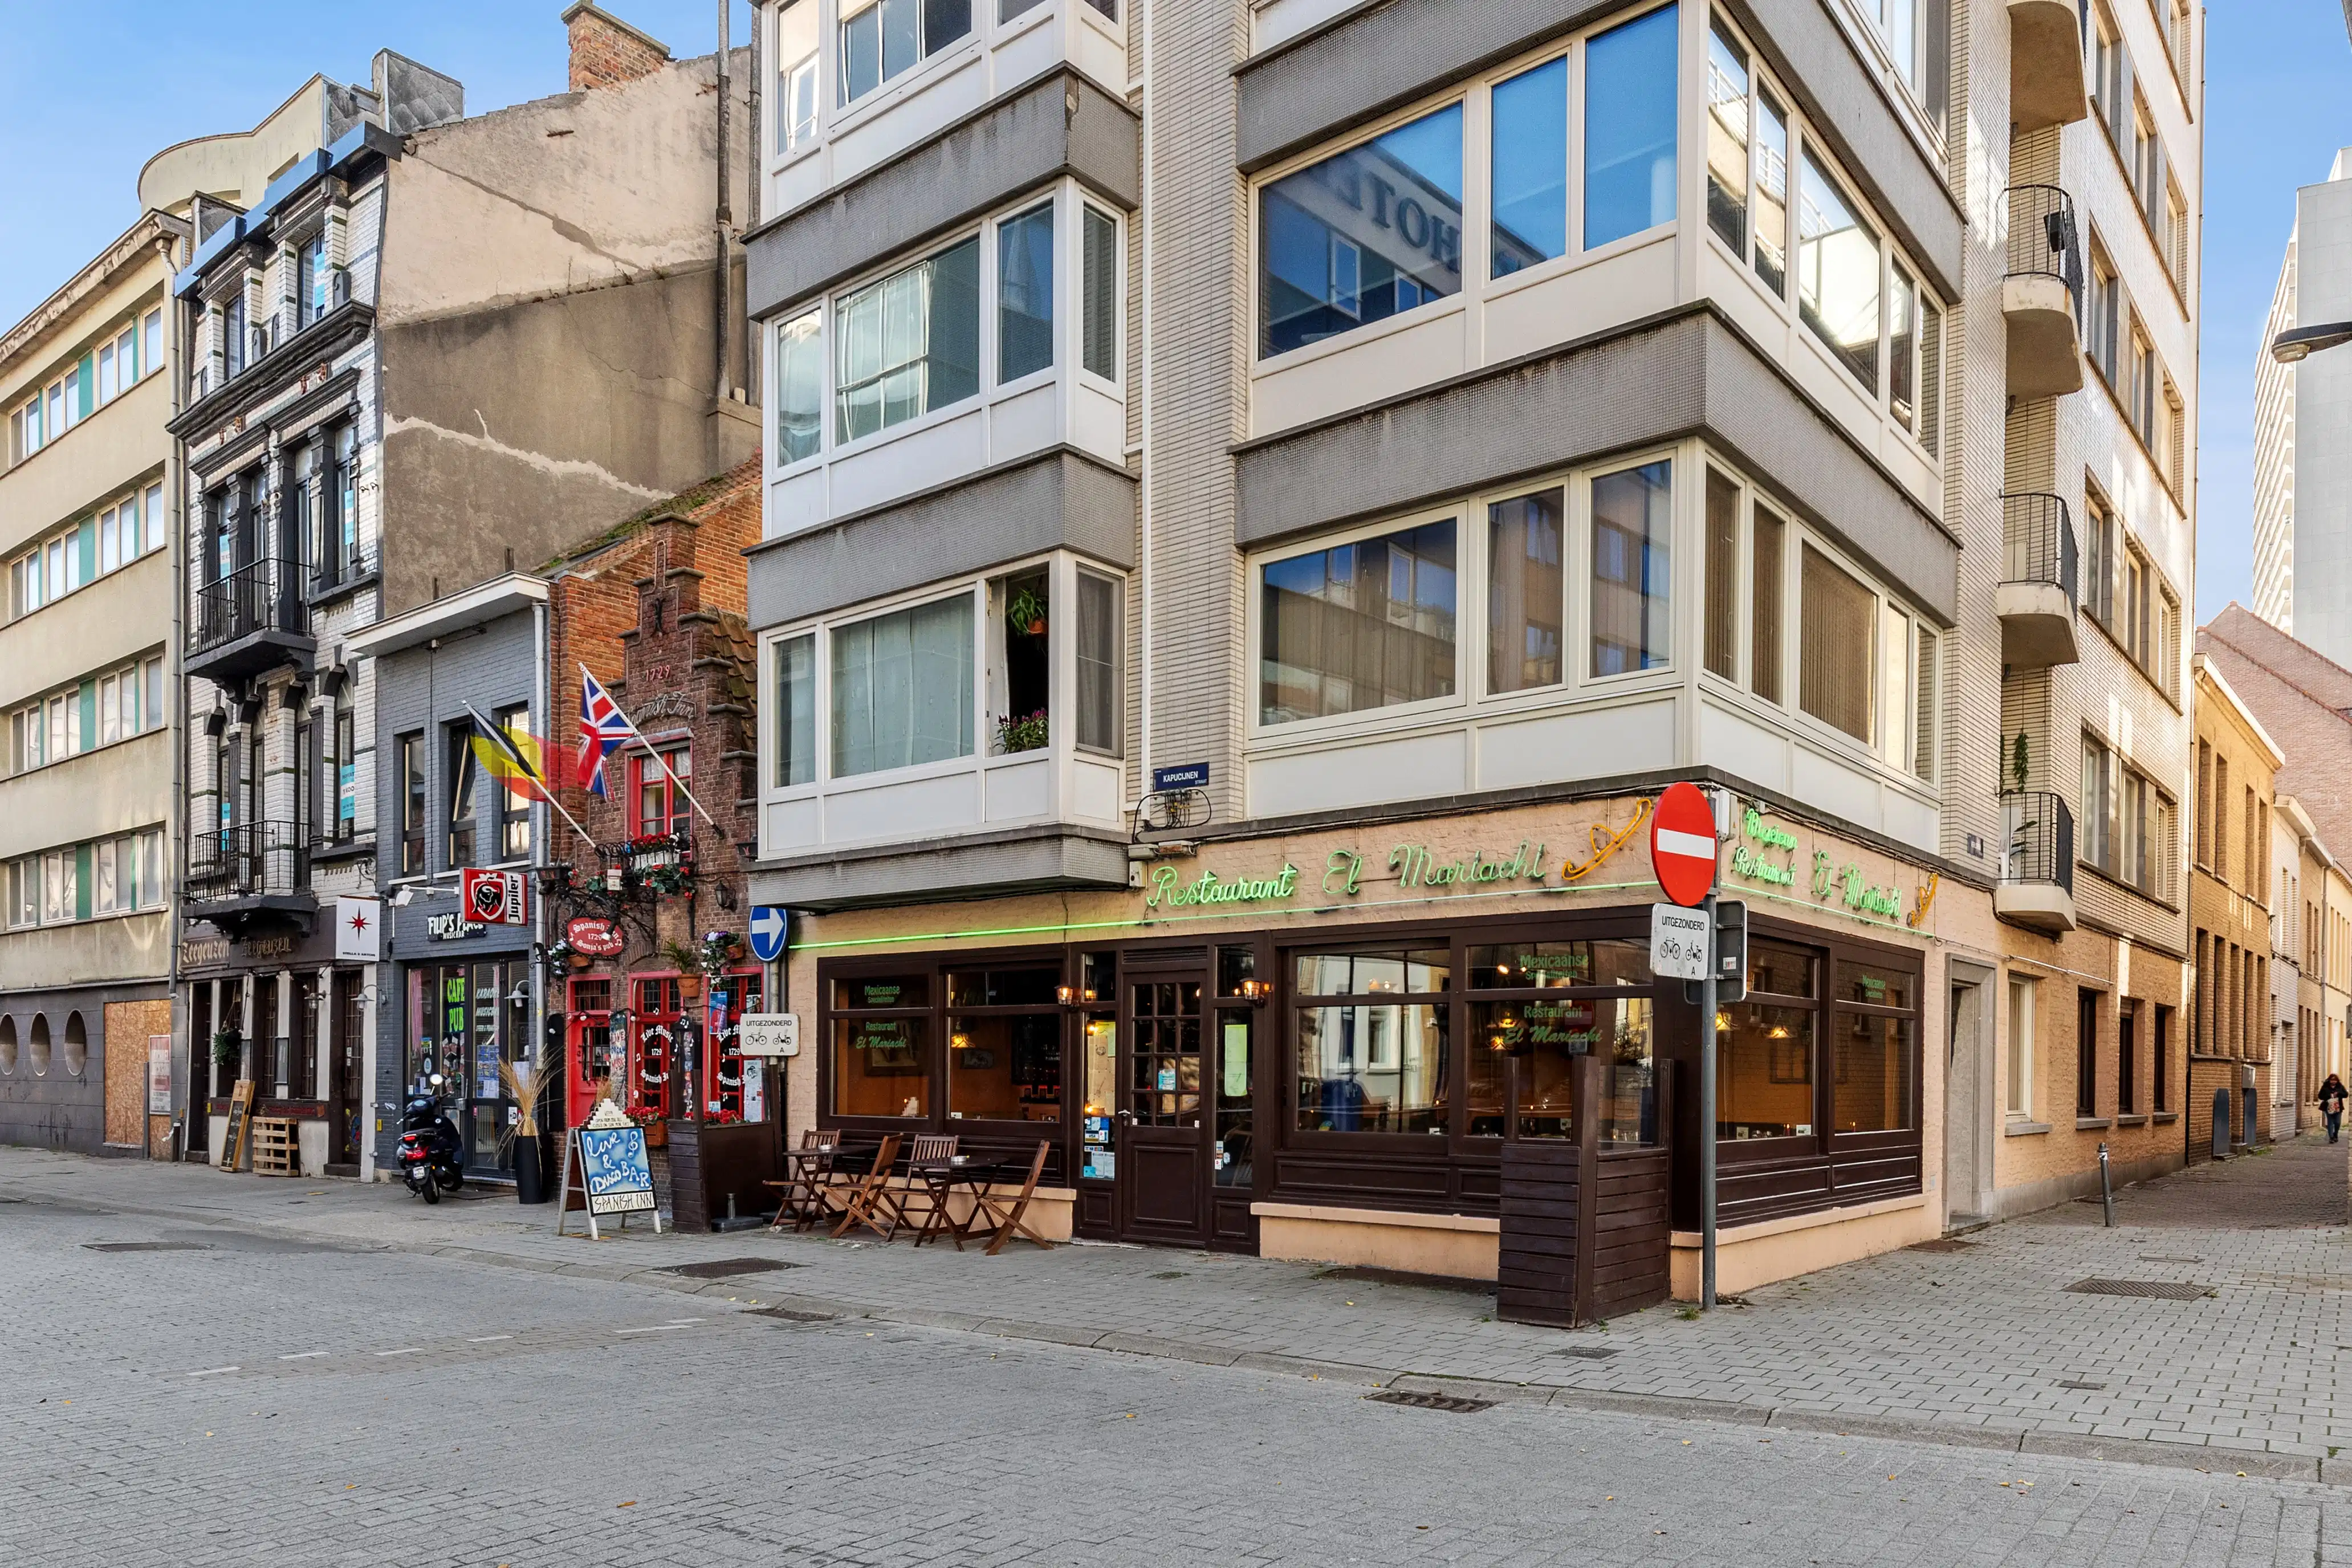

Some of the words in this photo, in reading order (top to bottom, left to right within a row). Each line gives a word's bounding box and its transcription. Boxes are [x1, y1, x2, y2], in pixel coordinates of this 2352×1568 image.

[645, 665, 670, 682] 1729
[667, 691, 694, 719] Inn
[1163, 771, 1198, 783] KAPUCIJNEN
[1147, 862, 1299, 906] Restaurant
[1322, 849, 1362, 894] El
[1390, 839, 1545, 887] Mariachi
[1815, 850, 1833, 897] El
[508, 875, 522, 922] Jupiler
[428, 913, 454, 935] FILIP'S
[573, 921, 605, 934] Spanish
[1662, 915, 1705, 931] UITGEZONDERD
[603, 942, 614, 951] pub
[1520, 954, 1589, 969] Mexicaanse
[1691, 966, 1696, 976] A
[864, 985, 900, 996] Mexicaanse
[1524, 1005, 1582, 1019] Restaurant
[449, 1007, 464, 1033] PUB
[865, 1021, 897, 1032] Restaurant
[640, 1027, 654, 1044] Live
[655, 1024, 674, 1044] Music
[716, 1028, 732, 1043] Live
[1504, 1025, 1524, 1044] El
[1529, 1026, 1604, 1044] Mariachi
[856, 1036, 866, 1049] El
[651, 1048, 662, 1056] 1729
[728, 1048, 740, 1056] 1729
[640, 1069, 662, 1084] Spanish
[717, 1071, 741, 1086] Spanish
[602, 1154, 616, 1170] &
